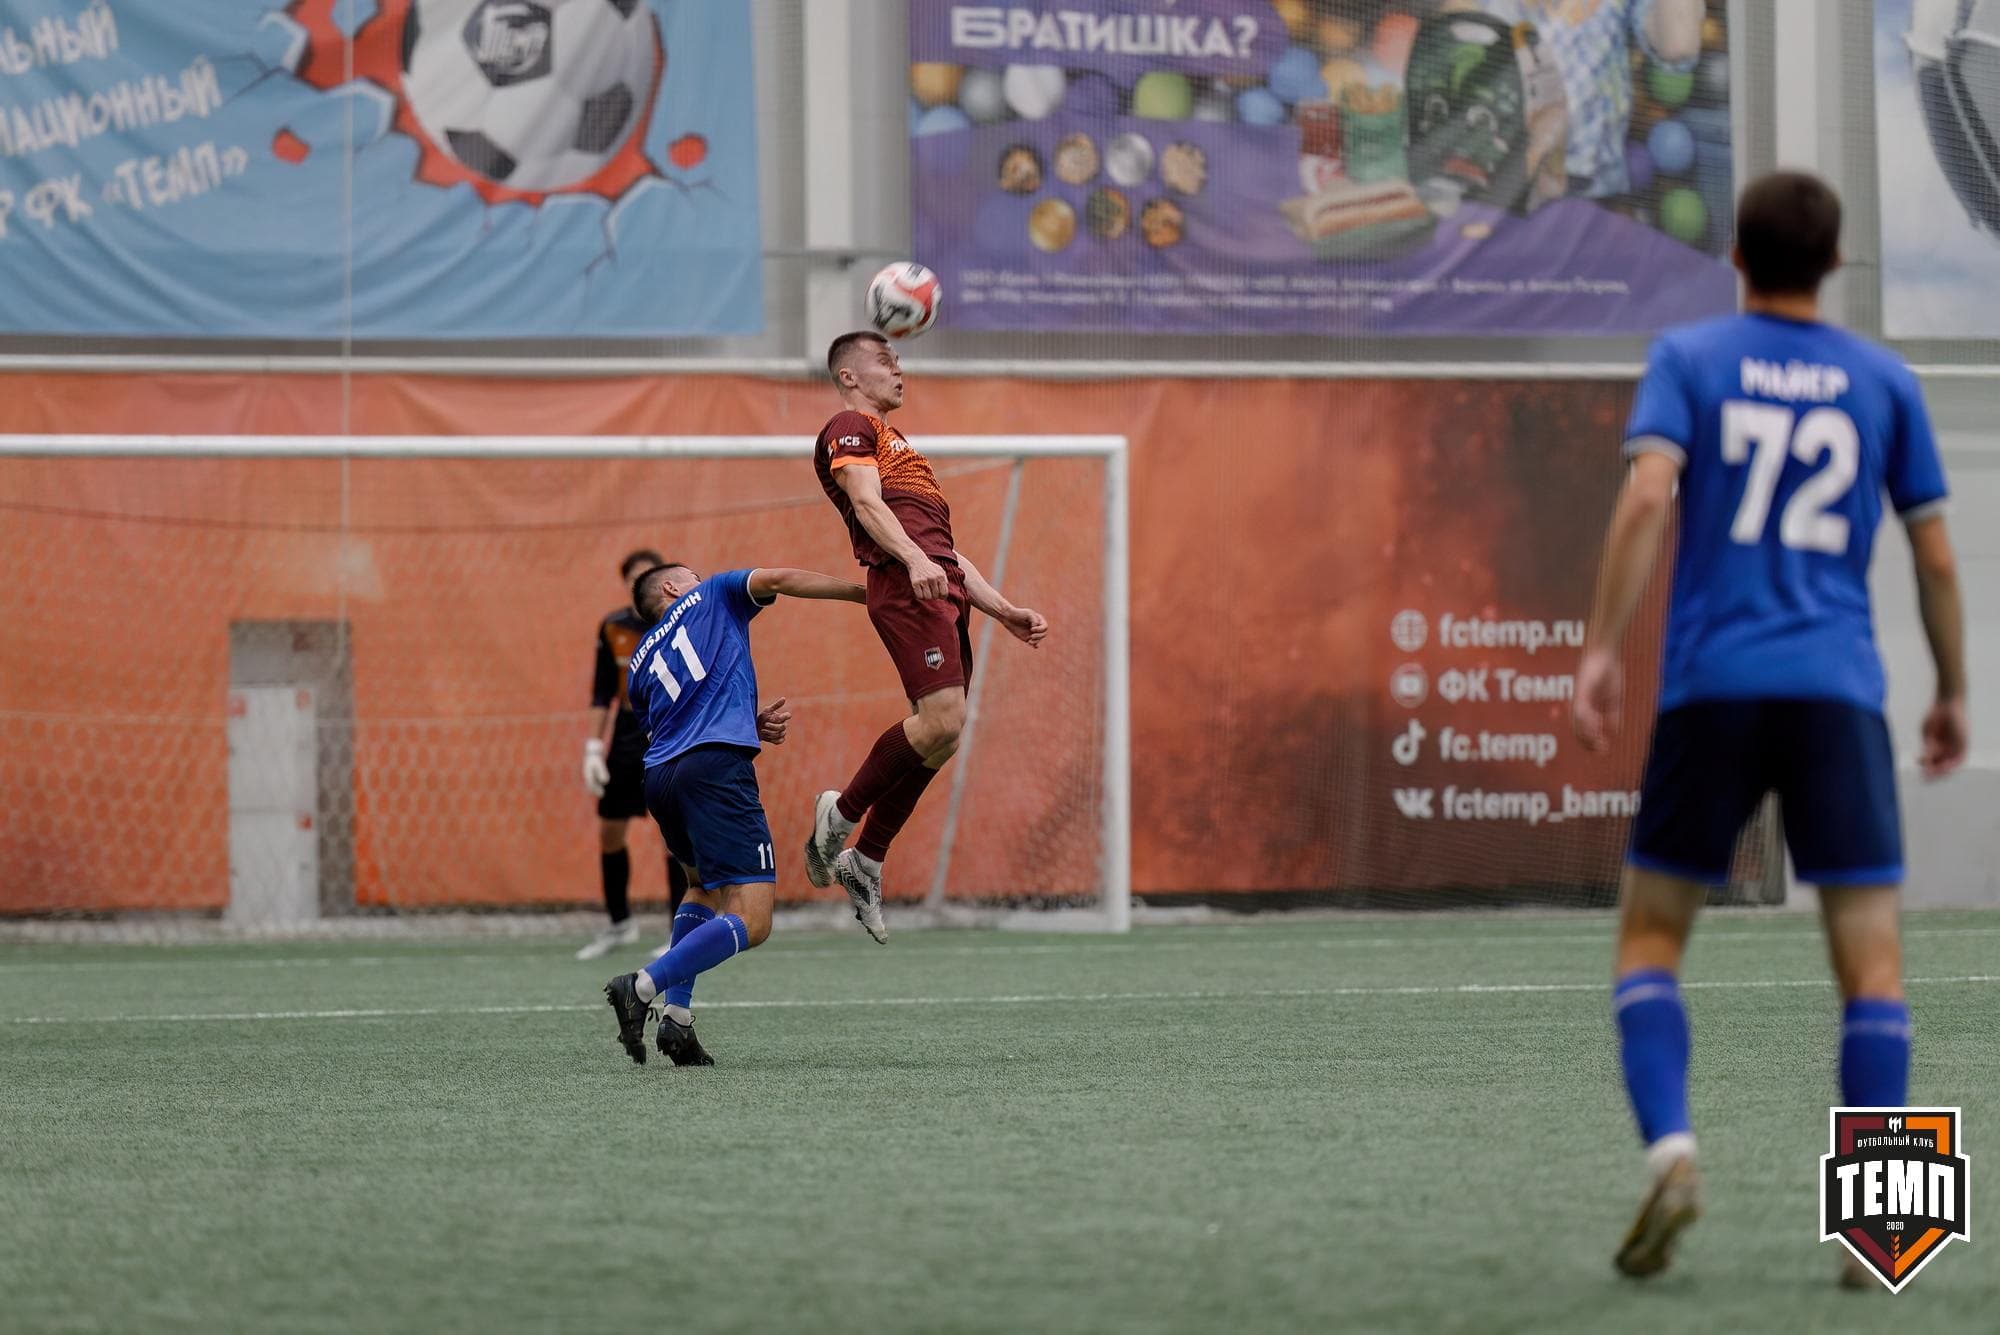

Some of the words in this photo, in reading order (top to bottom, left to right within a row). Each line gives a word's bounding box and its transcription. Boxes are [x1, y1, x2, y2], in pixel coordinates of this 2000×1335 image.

[951, 7, 1258, 57] БРАТИШКА?
[24, 172, 94, 228] ФК
[1740, 357, 1850, 403] МАЙЕР
[1720, 398, 1860, 556] 72
[1440, 613, 1585, 655] fctemp.ru
[649, 624, 707, 703] 11
[1438, 668, 1489, 703] ФК
[1494, 668, 1575, 701] Темп
[1439, 727, 1557, 768] fc.temp
[758, 843, 774, 869] 11
